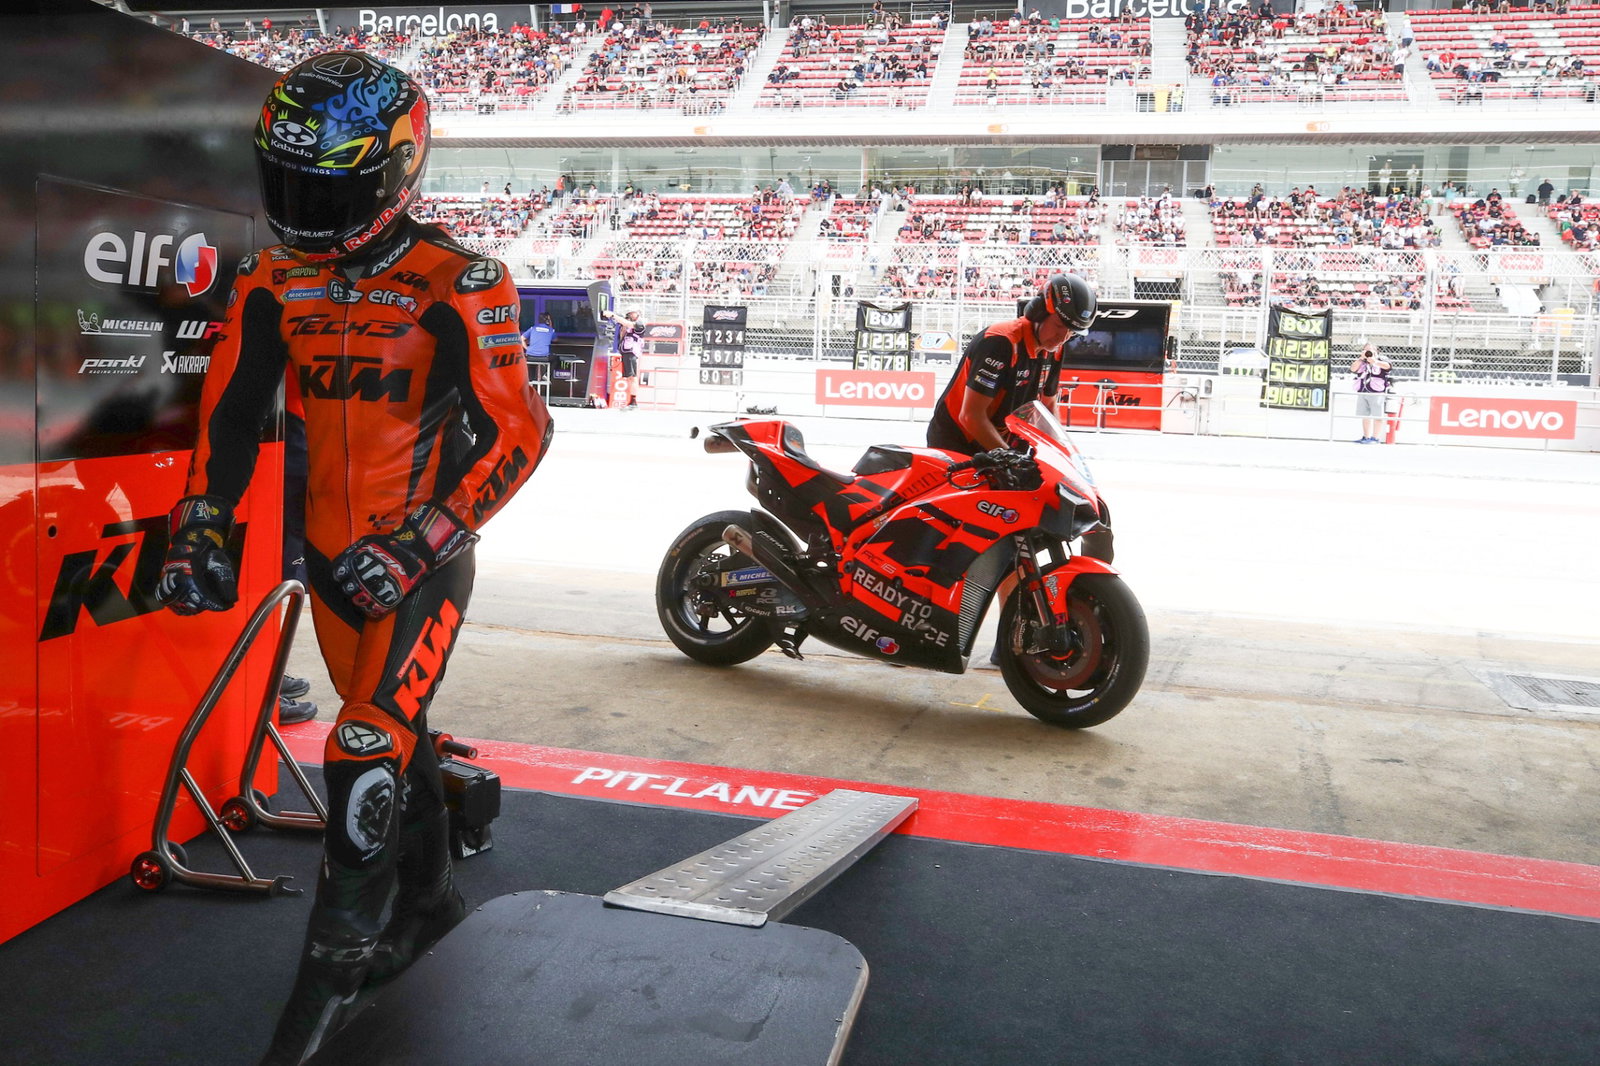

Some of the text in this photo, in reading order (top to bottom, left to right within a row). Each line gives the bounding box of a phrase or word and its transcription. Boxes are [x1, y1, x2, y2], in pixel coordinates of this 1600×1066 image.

[359, 7, 499, 36] Barcelona
[271, 138, 314, 159] Kabuto
[301, 165, 331, 175] WINGS
[359, 157, 391, 176] Kabuto
[298, 229, 335, 239] HELMETS
[343, 218, 384, 252] Red
[84, 230, 174, 288] elf
[371, 237, 411, 275] IXON
[390, 270, 430, 292] KTM
[1061, 285, 1069, 297] elf
[368, 289, 398, 303] elf
[477, 306, 509, 324] elf
[869, 311, 904, 328] BOX
[102, 319, 164, 332] MICHELIN
[176, 320, 225, 340] WP
[287, 313, 413, 339] TECH3
[1282, 318, 1323, 335] BOX
[861, 332, 907, 350] 1234
[1273, 339, 1327, 359] 1234
[77, 355, 147, 374] pankl
[178, 355, 211, 374] AKRAPO
[984, 357, 1000, 368] elf
[1270, 362, 1326, 382] 5678
[300, 354, 414, 403] KTM
[825, 376, 925, 401] Lenovo
[1106, 393, 1142, 406] KTM
[1440, 402, 1564, 431] Lenovo
[472, 445, 529, 525] KTM
[977, 500, 1006, 516] elf
[38, 513, 249, 642] KT
[740, 570, 773, 580] MICHEL
[853, 567, 932, 619] READY TO
[776, 604, 797, 615] RK
[839, 615, 880, 642] elf
[393, 598, 460, 722] KTM
[571, 766, 813, 811] PIT-LANE
